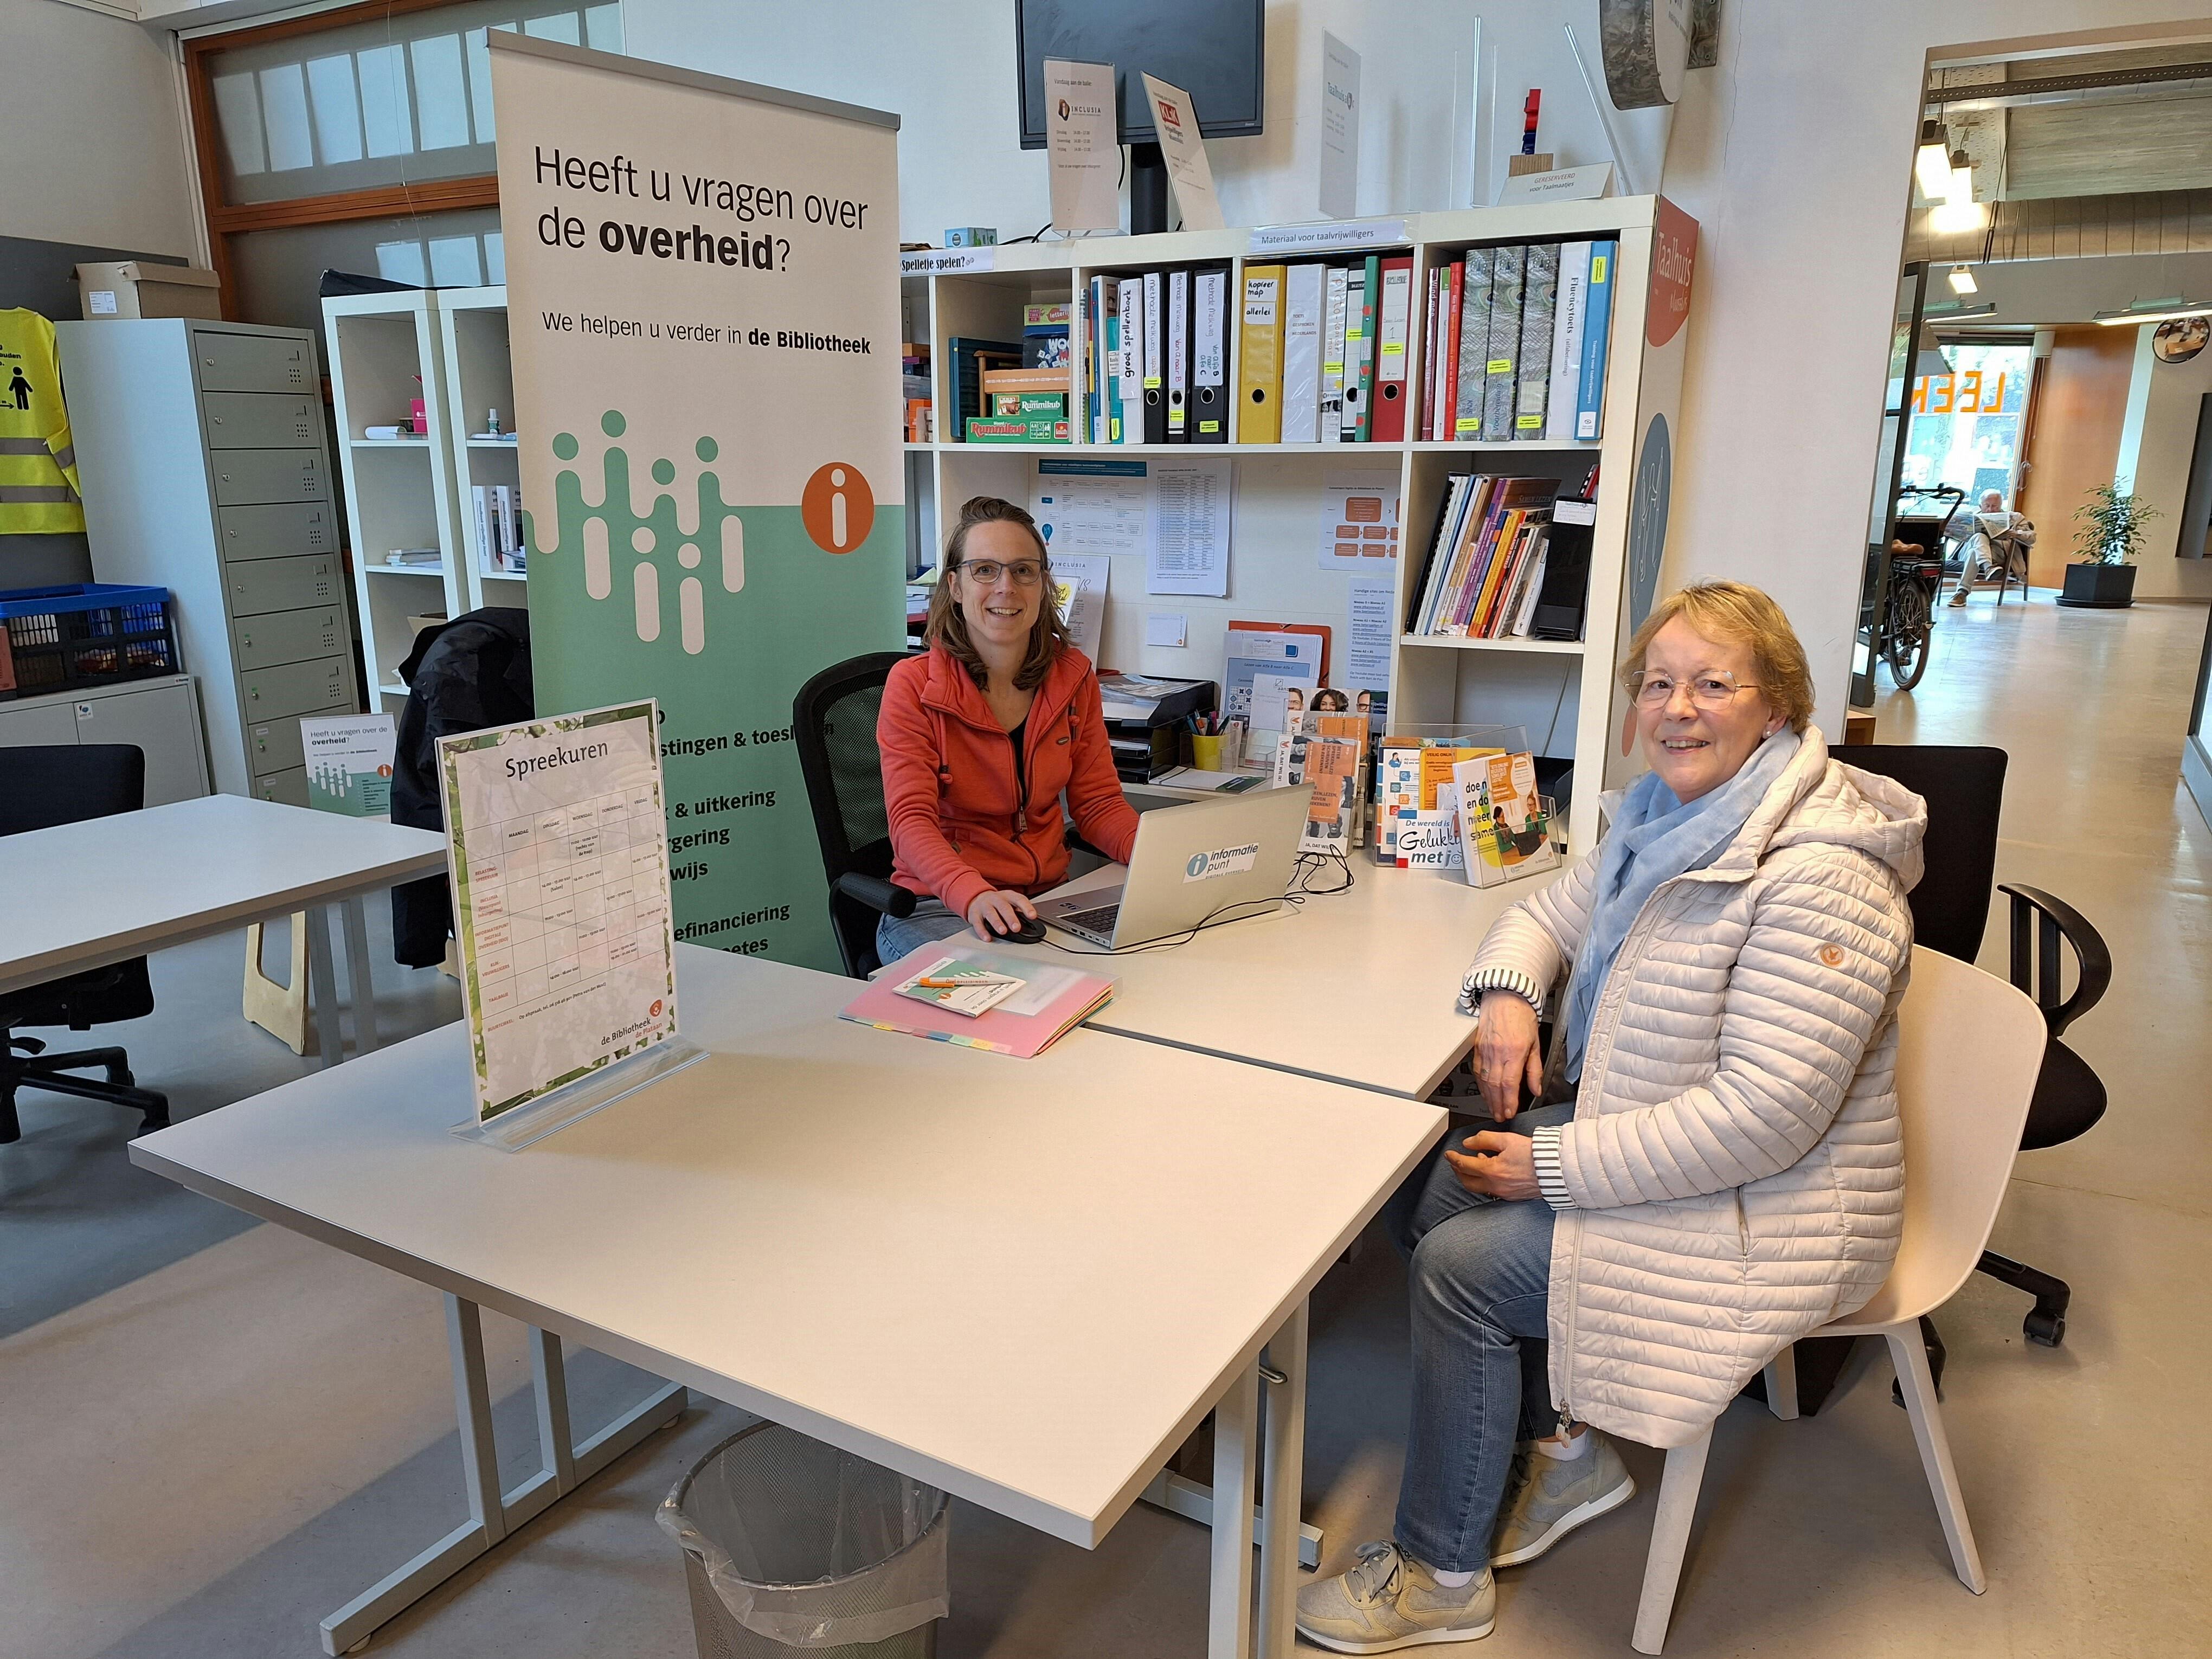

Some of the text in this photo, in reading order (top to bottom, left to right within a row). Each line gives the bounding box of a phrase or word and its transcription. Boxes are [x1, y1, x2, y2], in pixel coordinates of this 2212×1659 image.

[1534, 172, 1576, 183] GERESERVEERD
[1542, 181, 1574, 191] Taalmaatjes
[535, 145, 869, 230] Heeft u vragen over
[538, 206, 791, 273] de overheid?
[1262, 230, 1374, 244] Materiaal voor taalvrijwilligers
[902, 256, 966, 272] Spelletje spelen?
[1656, 231, 1692, 287] Taalhuis
[1248, 290, 1263, 298] map
[1246, 307, 1270, 316] allerlei
[1566, 277, 1579, 334] Fluencytoets
[542, 311, 872, 355] We helpen u verder in de Bibliotheek
[1121, 289, 1135, 378] groot spellenboek
[1049, 338, 1069, 349] WO
[1022, 401, 1060, 412] Rummikub
[971, 422, 1027, 438] Rummikub
[312, 737, 350, 745] overheid?
[660, 724, 795, 757] stingen & toesl
[505, 741, 608, 781] Spreekuren
[1465, 782, 1480, 793] doe
[674, 790, 776, 818] & uitkering
[1467, 797, 1489, 809] en do
[509, 829, 529, 838] MAANDAG
[572, 812, 593, 820] WOENSDAG
[602, 804, 623, 813] DONDERDAG
[1468, 813, 1490, 826] meer
[669, 828, 730, 853] gering
[1399, 827, 1461, 850] Gelukki
[1470, 828, 1495, 841] same
[1210, 844, 1258, 861] informatie
[1411, 851, 1443, 863] met
[669, 862, 709, 881] wijs
[1207, 859, 1230, 874] punt
[480, 895, 498, 903] INCLUSIA
[674, 904, 790, 941] efinanciering
[721, 937, 768, 955] etes
[601, 1017, 652, 1046] de Bibliotheek
[635, 1021, 663, 1039] de Plataan
